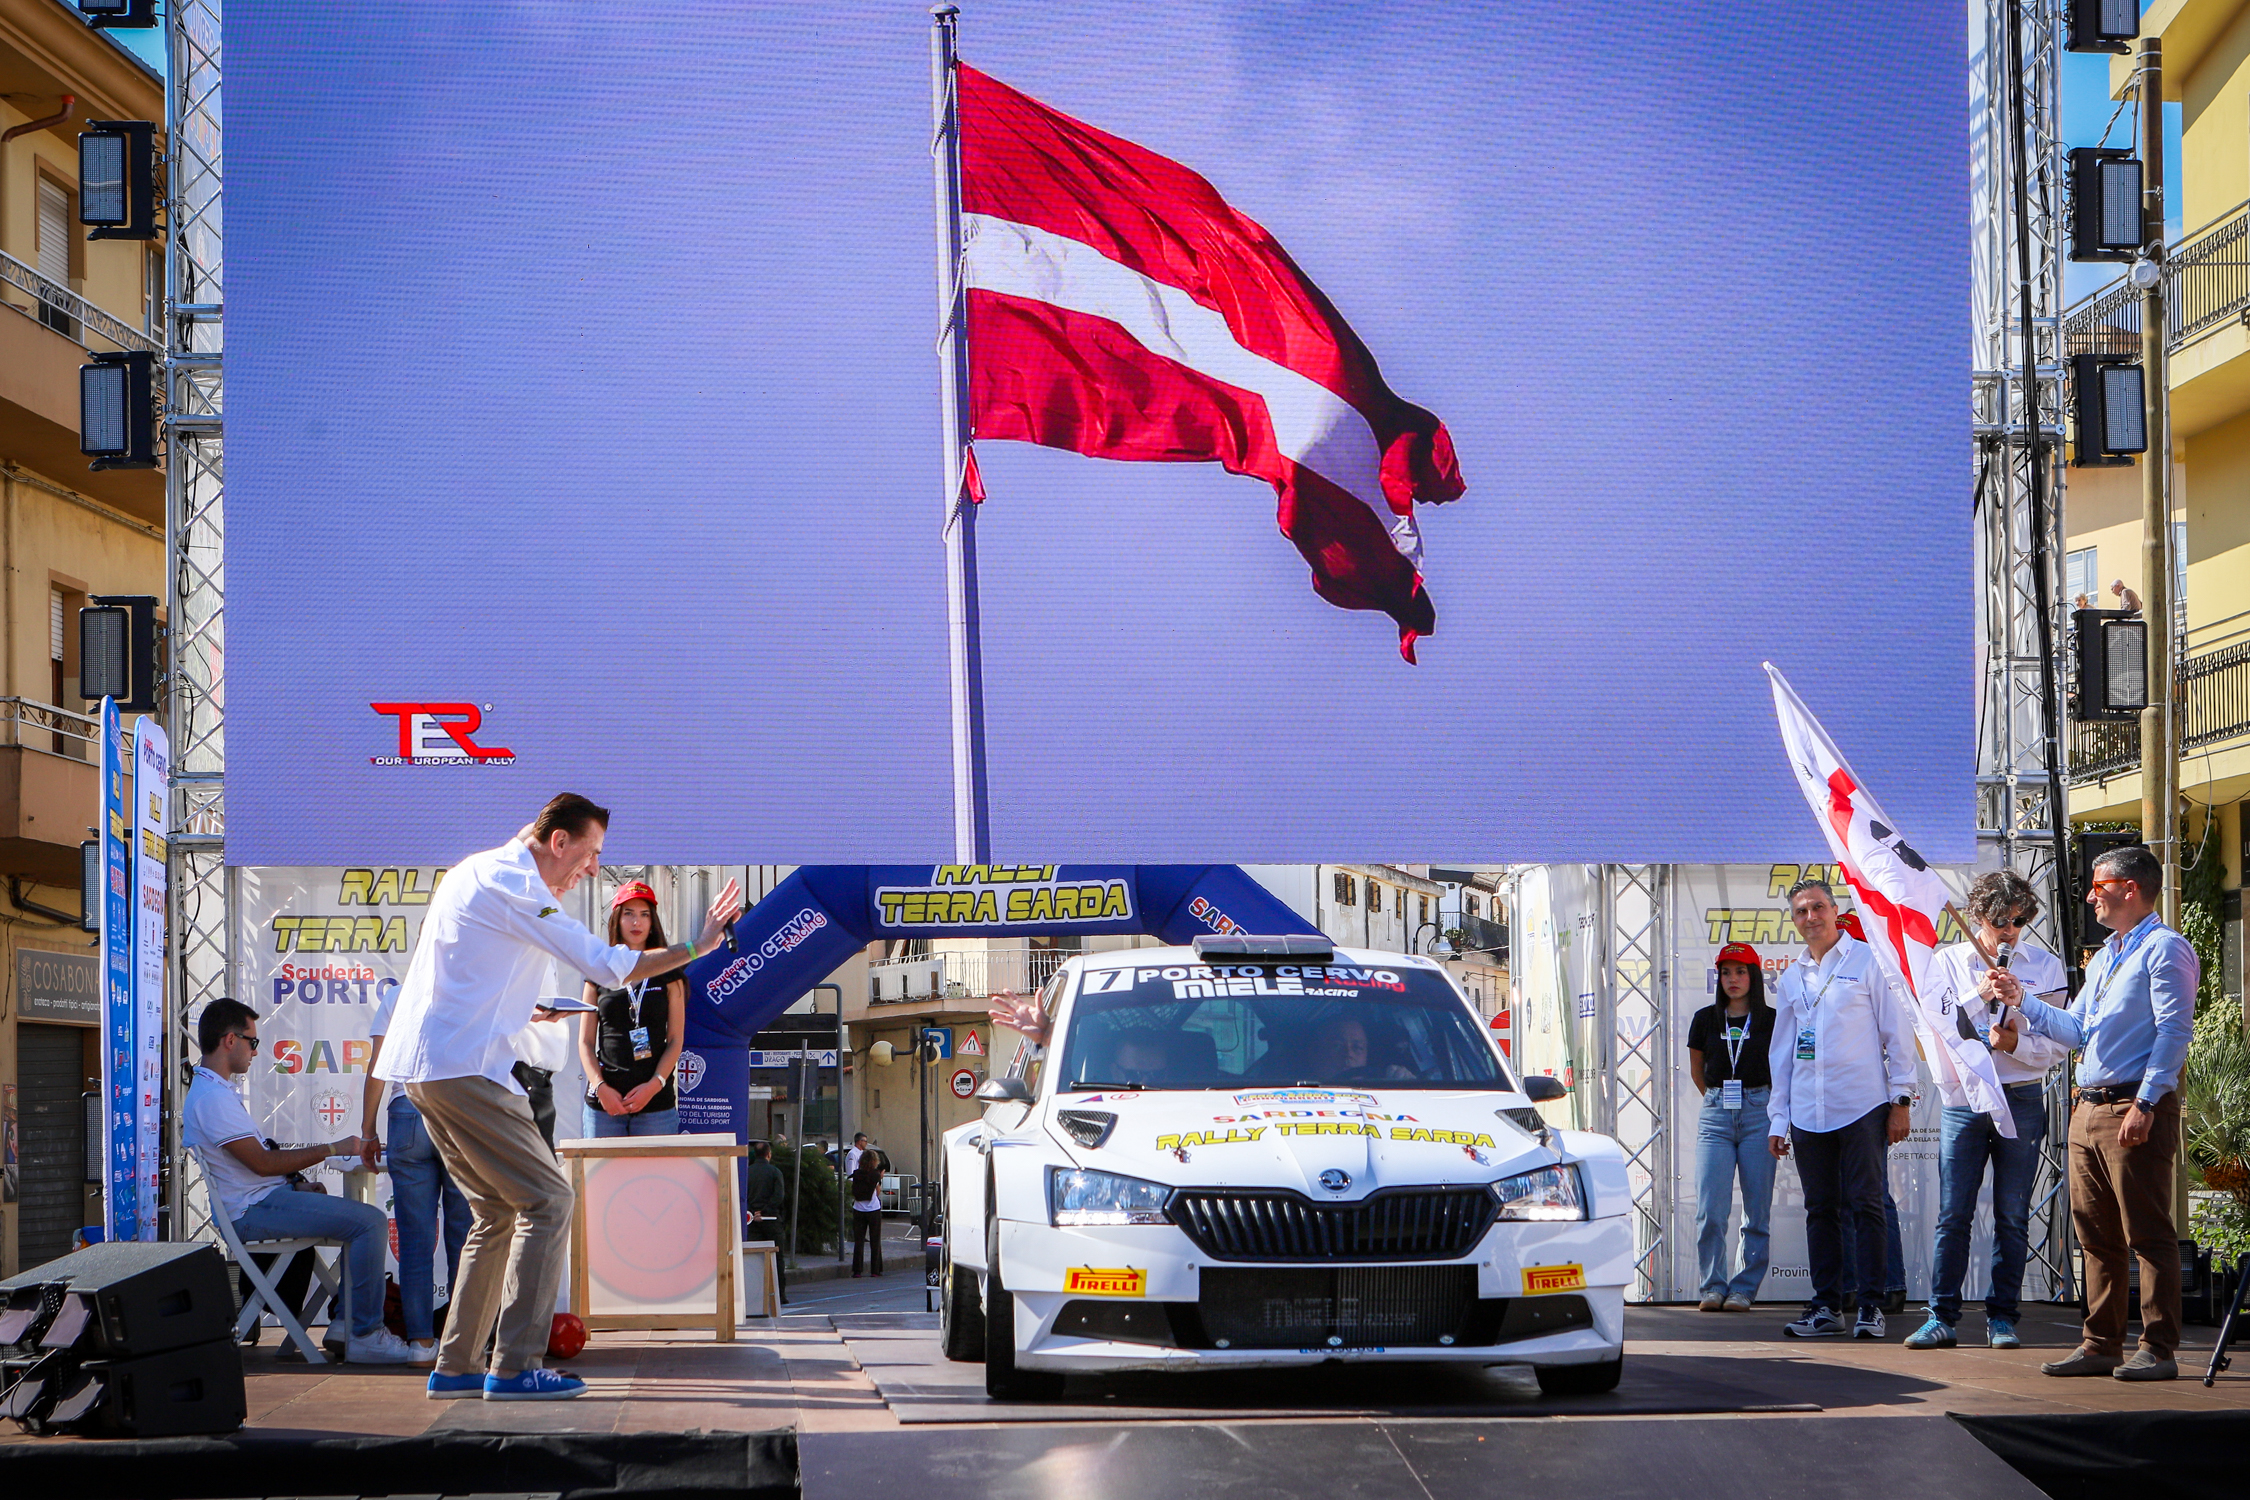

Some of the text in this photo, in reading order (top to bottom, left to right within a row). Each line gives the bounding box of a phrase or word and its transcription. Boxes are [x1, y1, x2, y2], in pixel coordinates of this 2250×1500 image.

[338, 868, 438, 906] RAL
[880, 883, 1128, 923] TERRA SARDA
[272, 915, 407, 953] TERRA
[782, 913, 827, 951] Racing
[708, 909, 815, 1004] PORTO CERVO
[281, 963, 374, 981] Scuderia
[708, 957, 747, 991] Scuderia
[1099, 966, 1400, 991] 7 PORTO CERVO
[273, 1039, 371, 1075] SAR
[1213, 1110, 1421, 1124] SARDEGNA
[1156, 1123, 1496, 1150] RALLY TERRA SARDA
[1893, 1152, 1940, 1160] SPETTACOL
[1070, 1272, 1139, 1292] PIRELLI
[1527, 1268, 1580, 1290] PIRELLI
[1771, 1266, 1809, 1278] Provin
